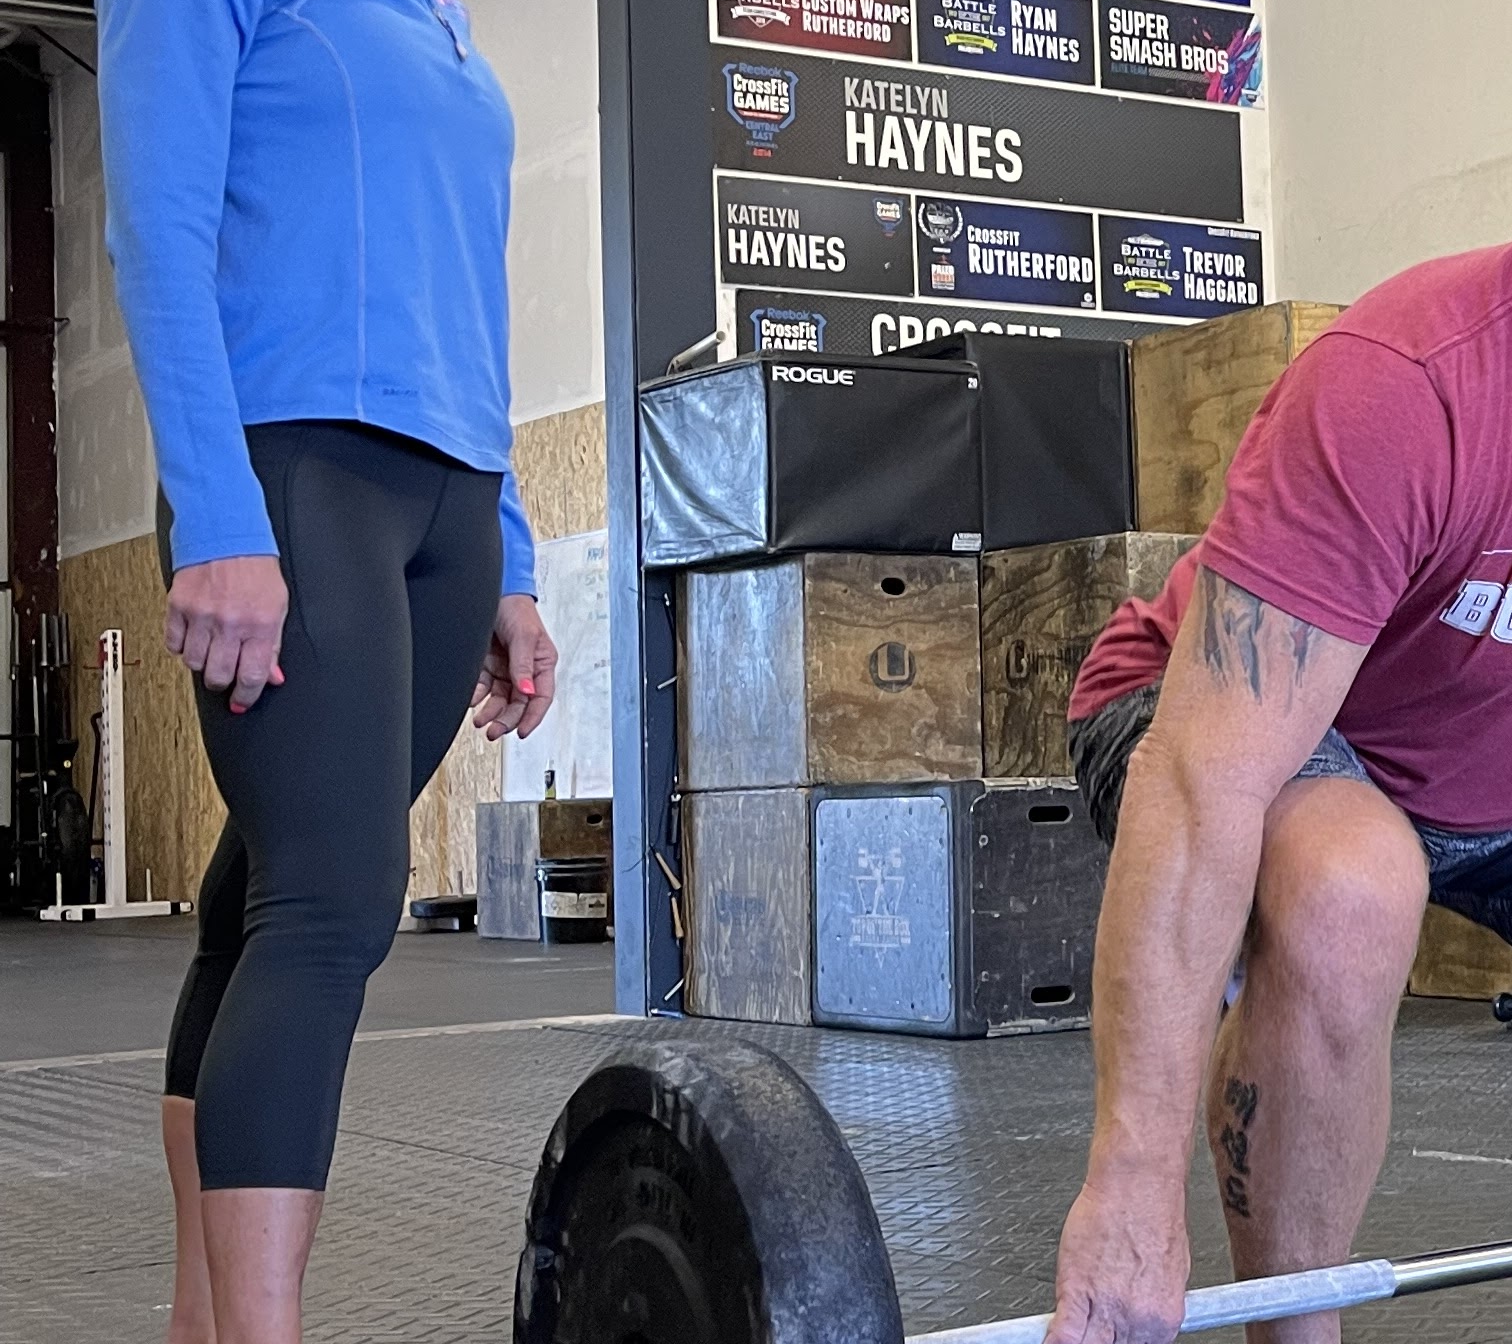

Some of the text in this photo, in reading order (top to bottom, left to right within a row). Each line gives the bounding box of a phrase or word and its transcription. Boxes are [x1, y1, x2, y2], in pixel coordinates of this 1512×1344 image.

[802, 11, 891, 43] RUTHERFORD
[933, 14, 1006, 36] BARBELLS
[1010, 0, 1057, 32] RYAN
[1109, 7, 1169, 41] SUPER
[1012, 27, 1080, 63] HAYNES
[1109, 35, 1229, 74] SMASH BROS
[733, 73, 789, 96] CrossFit
[843, 76, 949, 119] KATELYN
[733, 91, 790, 114] GAMES
[845, 110, 1023, 183] HAYNES
[727, 203, 800, 229] KATELYN
[727, 228, 846, 272] HAYNES
[967, 224, 1020, 247] CROSSFIT
[967, 242, 1094, 283] RUTHERFORD
[1121, 244, 1171, 260] BATTLE
[1182, 246, 1246, 278] TREVOR
[1113, 263, 1180, 281] BARBELLS
[1184, 273, 1258, 305] HAGGARD
[761, 318, 817, 340] CrossFit
[772, 365, 855, 386] ROGUE
